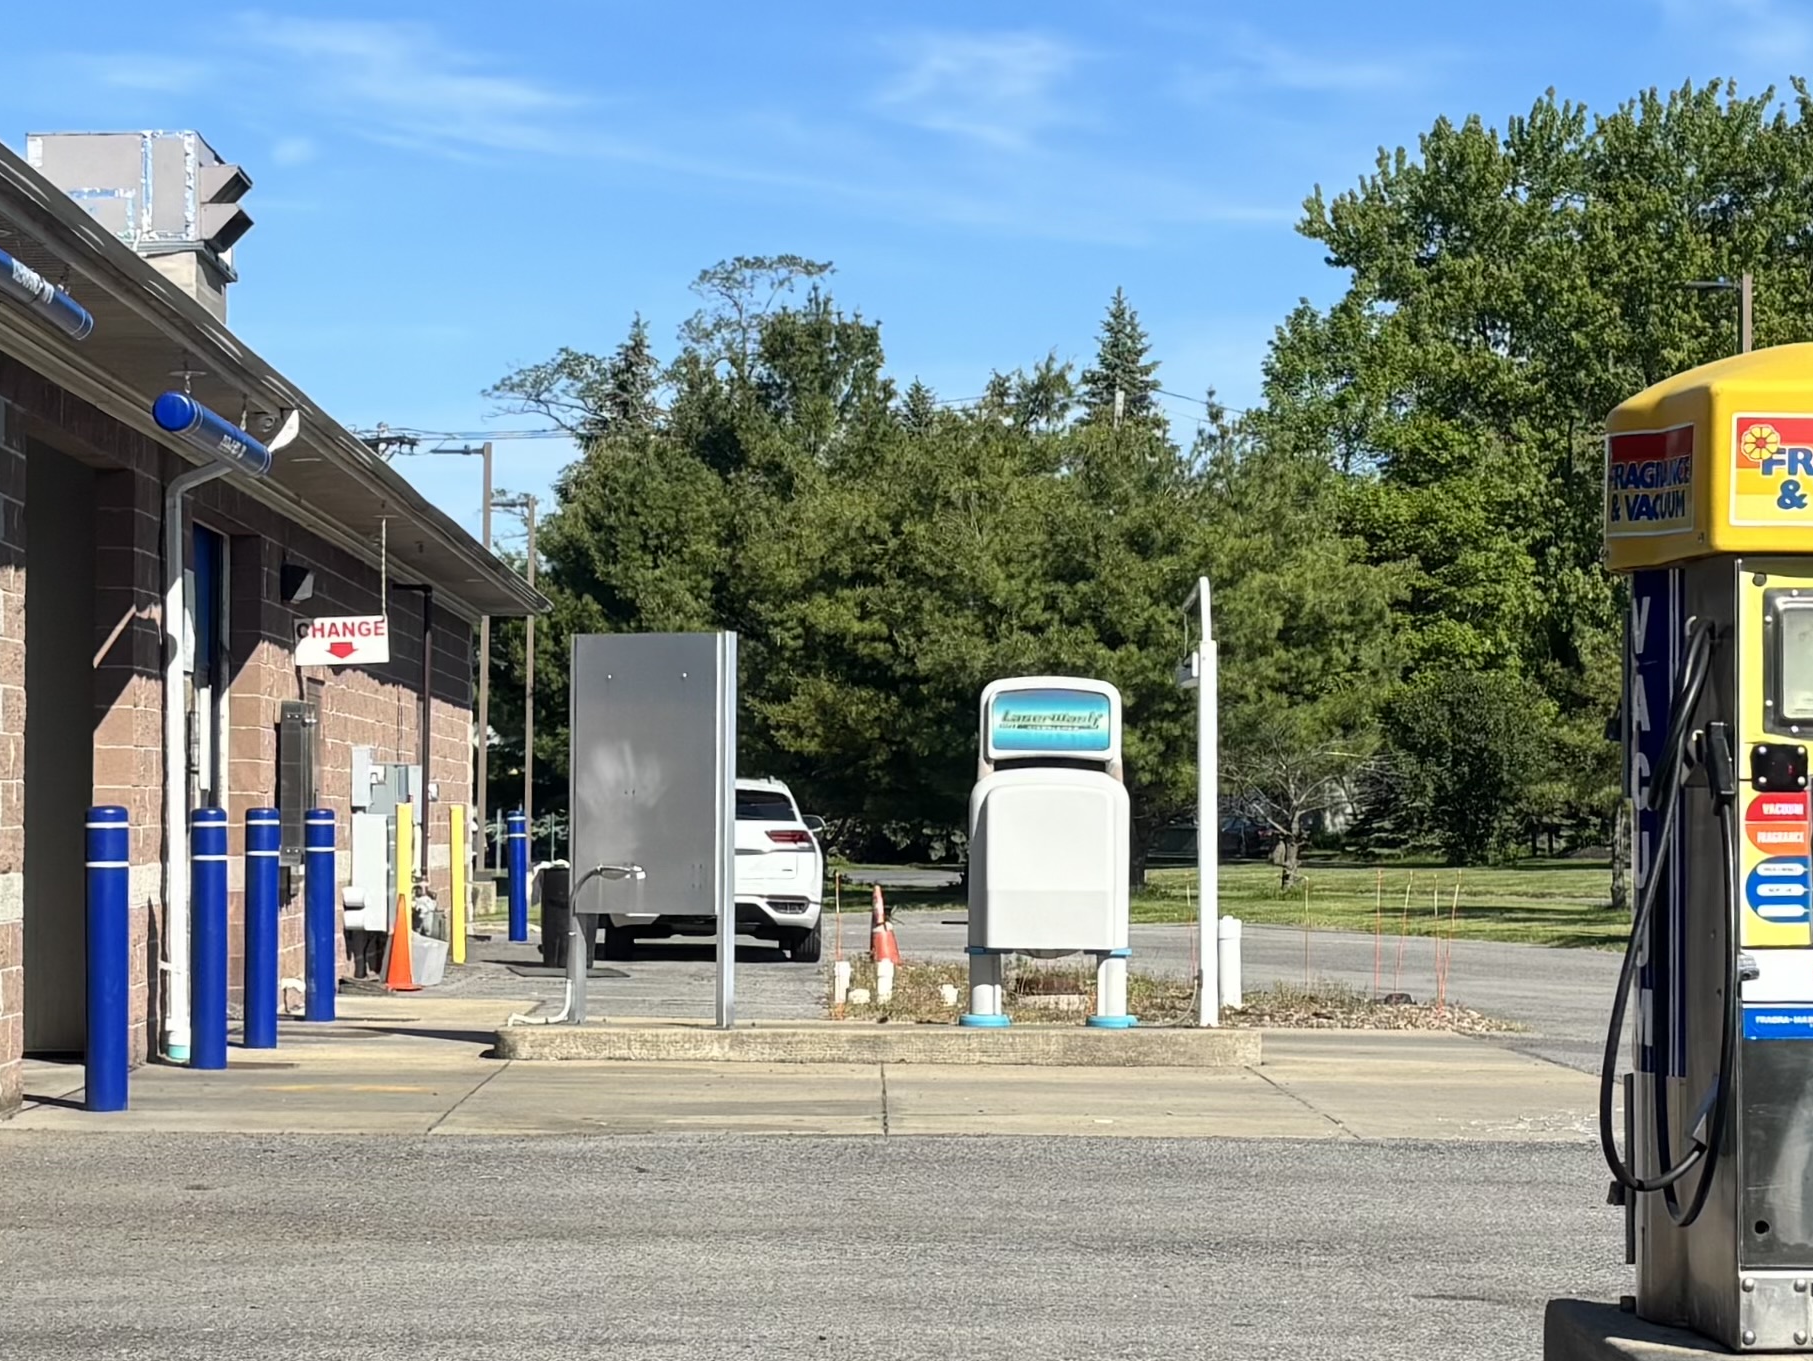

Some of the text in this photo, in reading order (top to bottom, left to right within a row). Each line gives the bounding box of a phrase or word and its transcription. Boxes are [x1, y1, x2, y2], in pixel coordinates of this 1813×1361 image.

[1624, 489, 1686, 522] VACUUM
[1776, 479, 1808, 510] &
[296, 621, 385, 639] CHANGE
